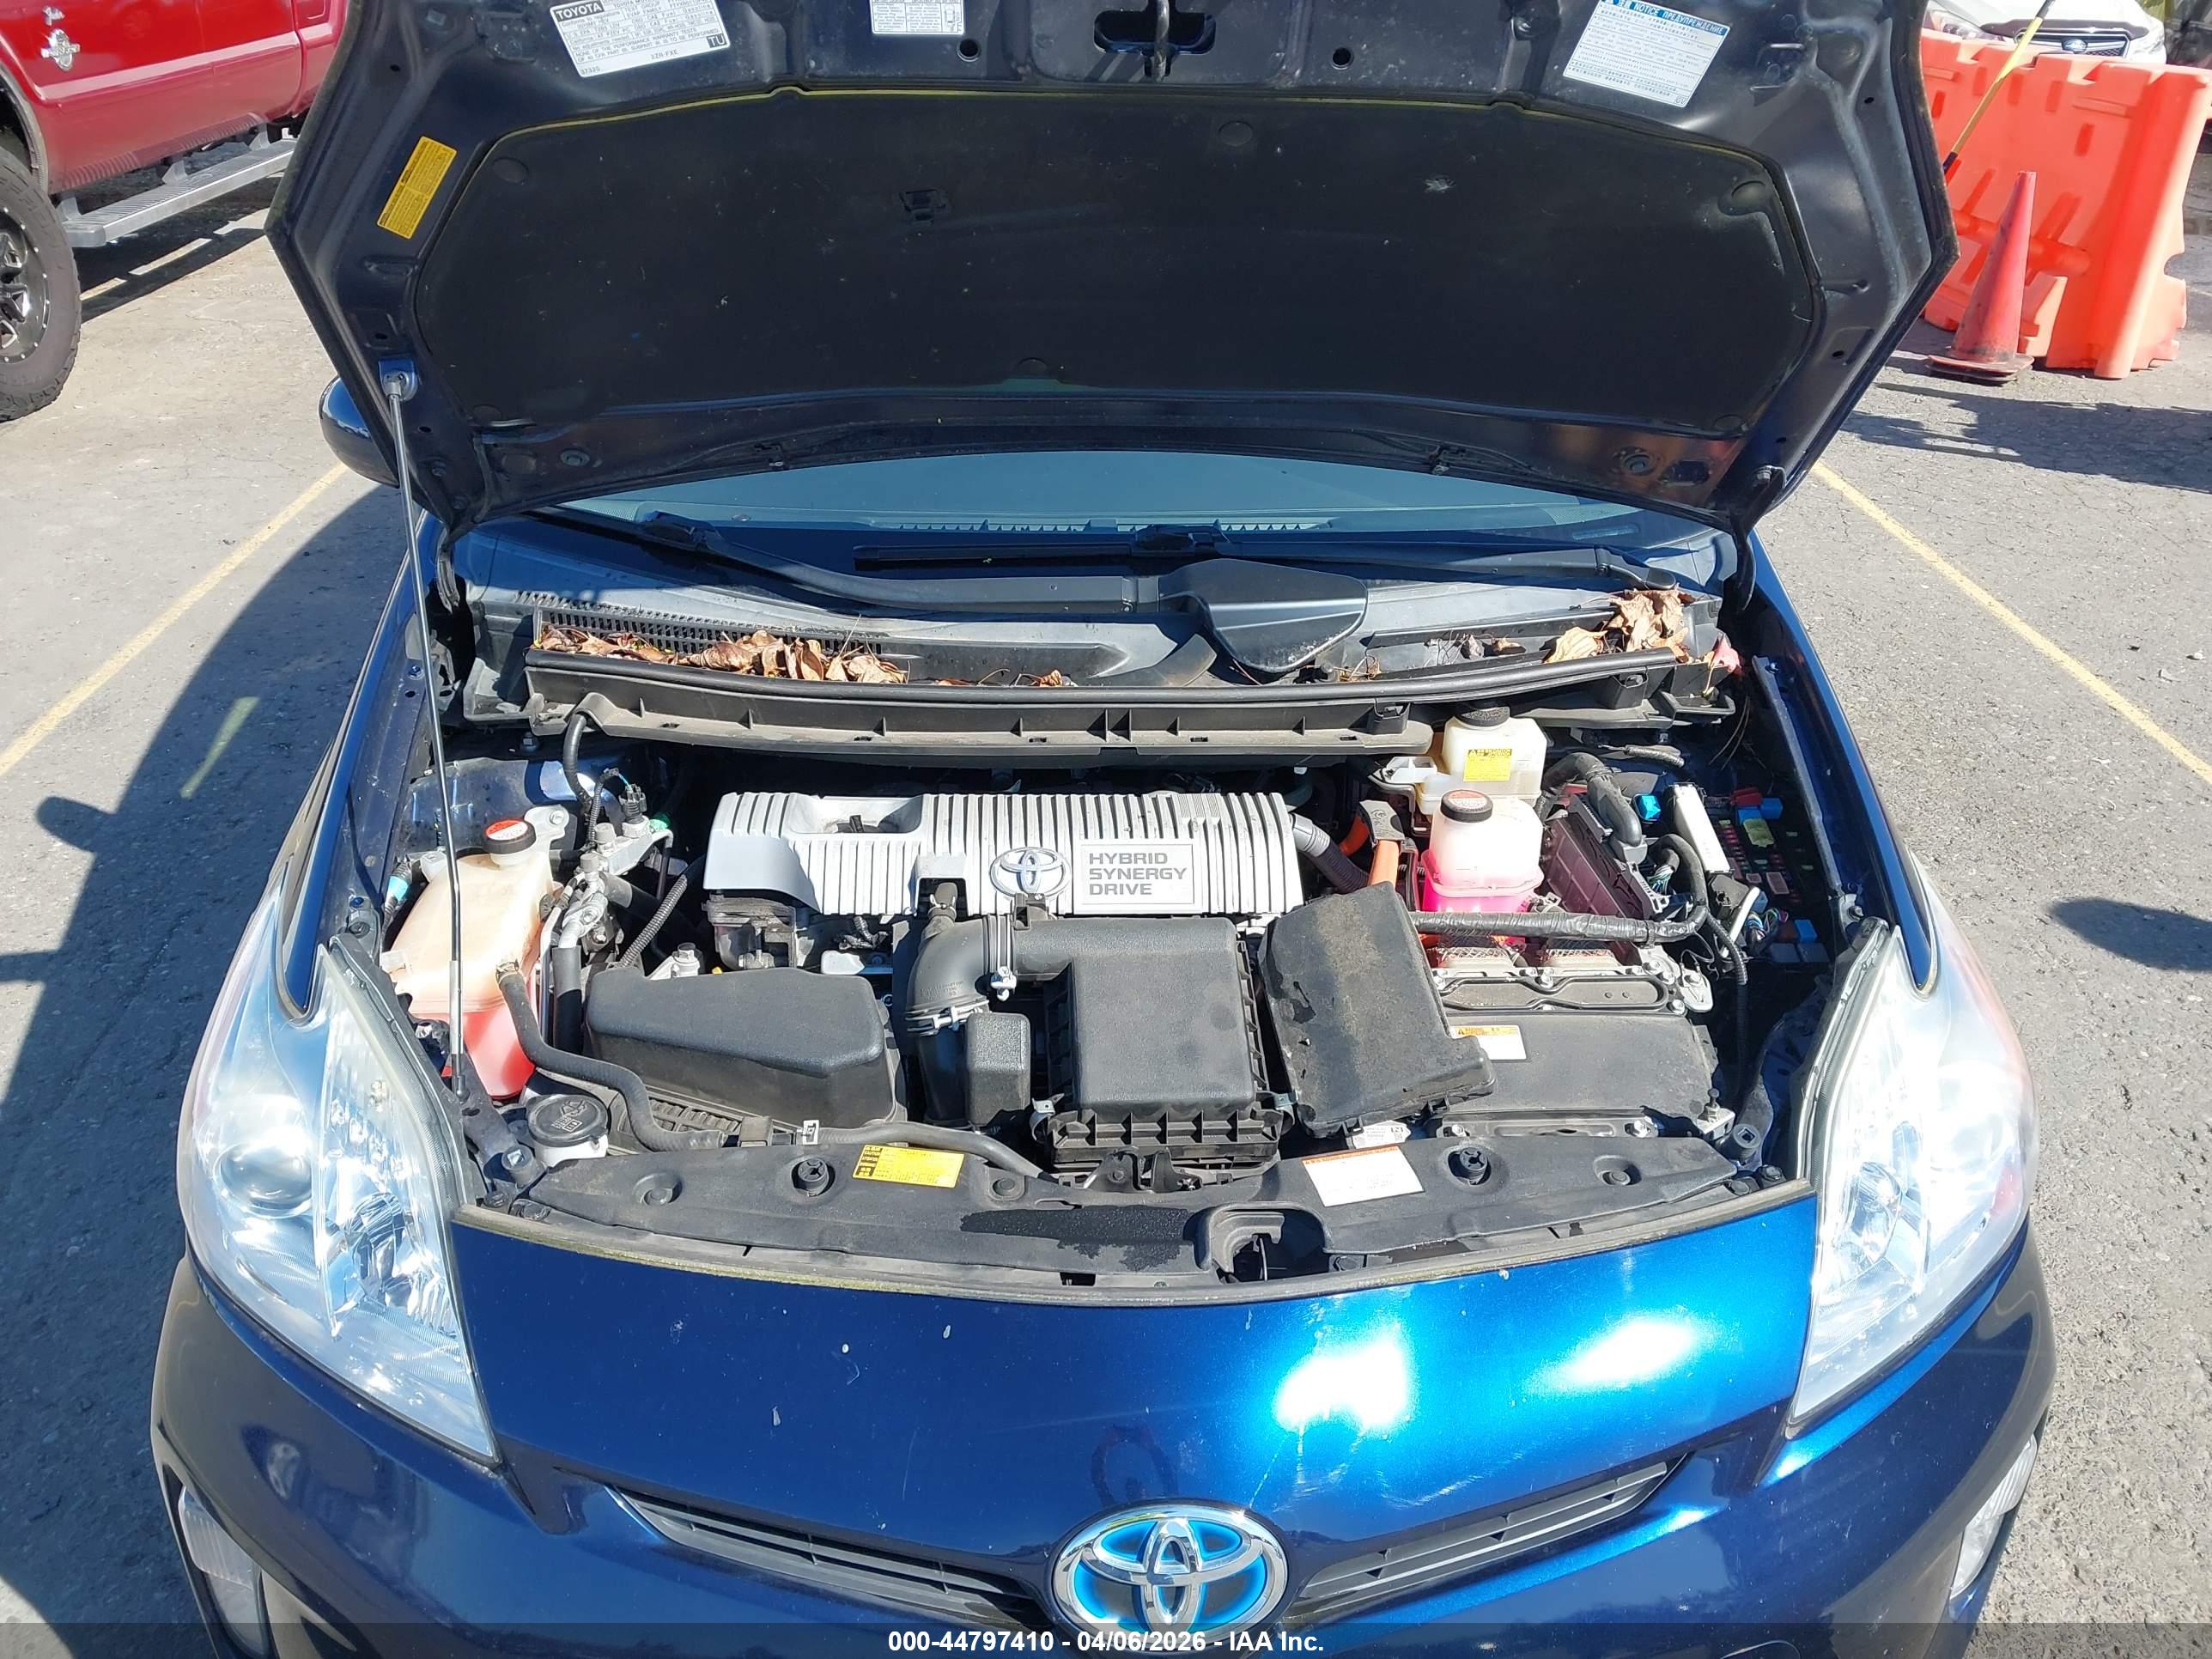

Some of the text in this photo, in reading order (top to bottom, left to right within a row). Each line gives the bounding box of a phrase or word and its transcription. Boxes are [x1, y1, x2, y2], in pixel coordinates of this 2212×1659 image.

[556, 3, 603, 21] TOYOTA
[1633, 3, 1659, 16] NOTICE
[708, 34, 726, 46] TU
[1089, 853, 1168, 865] HYBRID
[1089, 868, 1187, 880] SYNERGY
[1089, 884, 1152, 896] DRIVE
